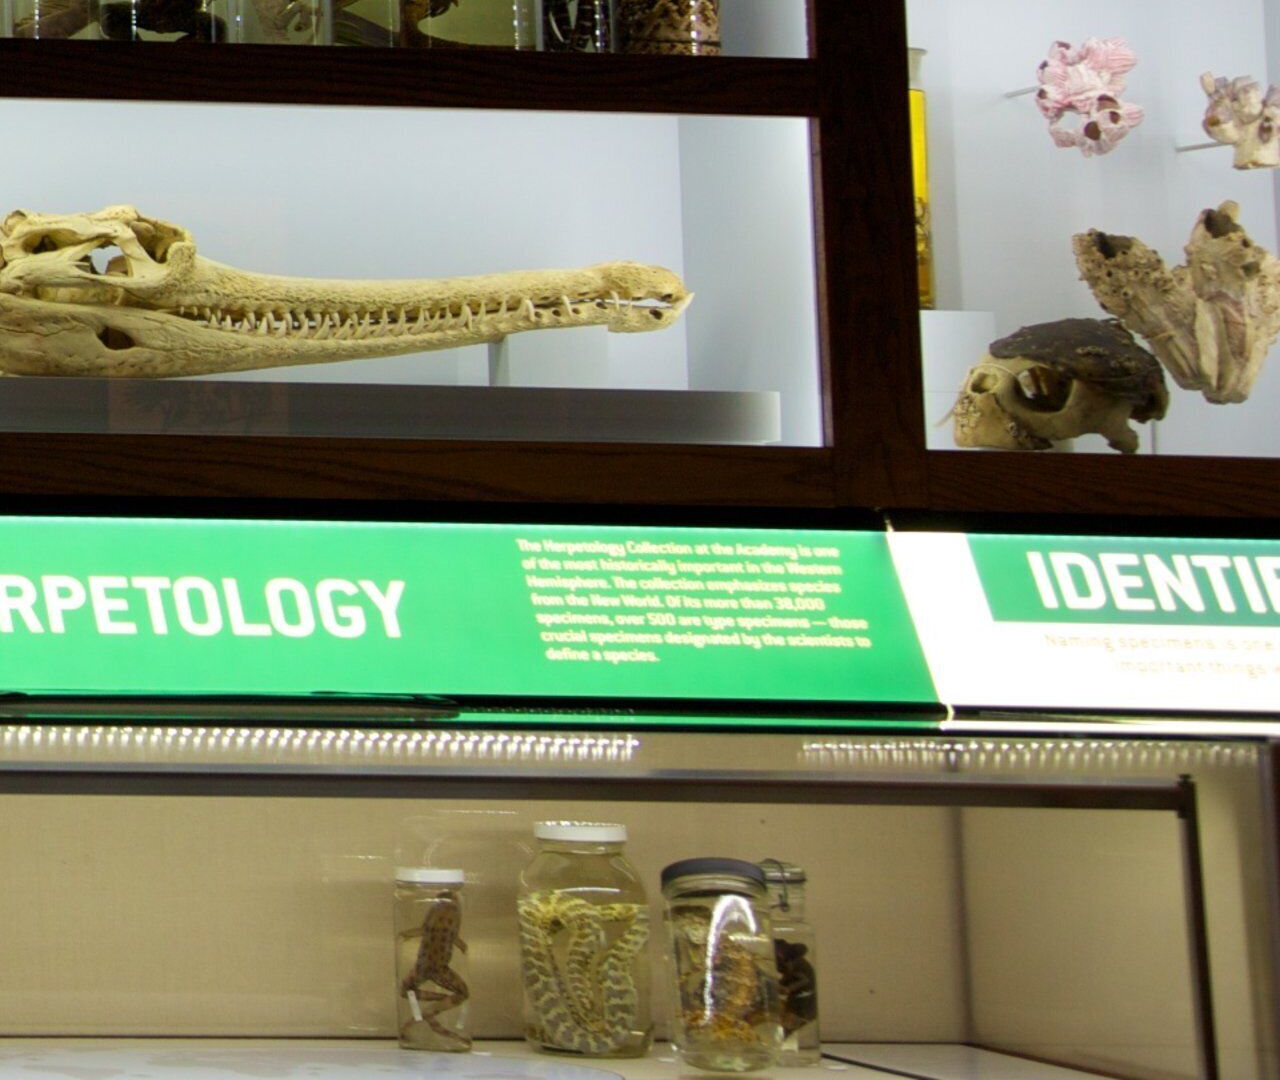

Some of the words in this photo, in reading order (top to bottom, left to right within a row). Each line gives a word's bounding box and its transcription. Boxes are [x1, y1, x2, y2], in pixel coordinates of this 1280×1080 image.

[515, 538, 541, 553] The
[542, 539, 626, 557] Herpetology
[626, 540, 692, 555] Collection
[694, 543, 709, 555] at
[710, 542, 734, 556] the
[736, 543, 798, 560] Academy
[797, 544, 812, 557] is
[813, 546, 840, 558] one
[521, 556, 536, 570] of
[537, 557, 561, 570] the
[562, 559, 599, 571] most
[599, 558, 677, 576] historically
[676, 559, 745, 576] important
[744, 560, 761, 573] in
[760, 561, 785, 574] the
[784, 561, 843, 576] Western
[525, 574, 611, 591] Hemisphere.
[611, 576, 637, 589] The
[638, 577, 705, 591] collection
[705, 578, 788, 594] emphasizes
[788, 580, 842, 596] species
[1026, 550, 1280, 614] IDENTIF
[530, 592, 565, 606] from
[564, 593, 589, 606] the
[589, 594, 621, 607] New
[620, 594, 664, 608] World.
[664, 595, 681, 608] Of
[682, 595, 702, 609] its
[703, 598, 739, 610] more
[740, 596, 773, 610] than
[535, 611, 615, 627] specimens,
[614, 614, 645, 625] over
[646, 612, 676, 626] 500
[677, 615, 702, 627] are
[702, 614, 735, 631] type
[736, 614, 811, 631] specimens
[827, 616, 869, 629] those
[540, 629, 588, 643] crucial
[588, 630, 663, 646] specimens
[664, 631, 740, 649] designated
[740, 632, 762, 650] by
[761, 633, 786, 647] the
[786, 633, 855, 648] scientists
[854, 635, 872, 648] to
[545, 647, 590, 661] define
[591, 650, 602, 661] a
[602, 648, 661, 665] species.
